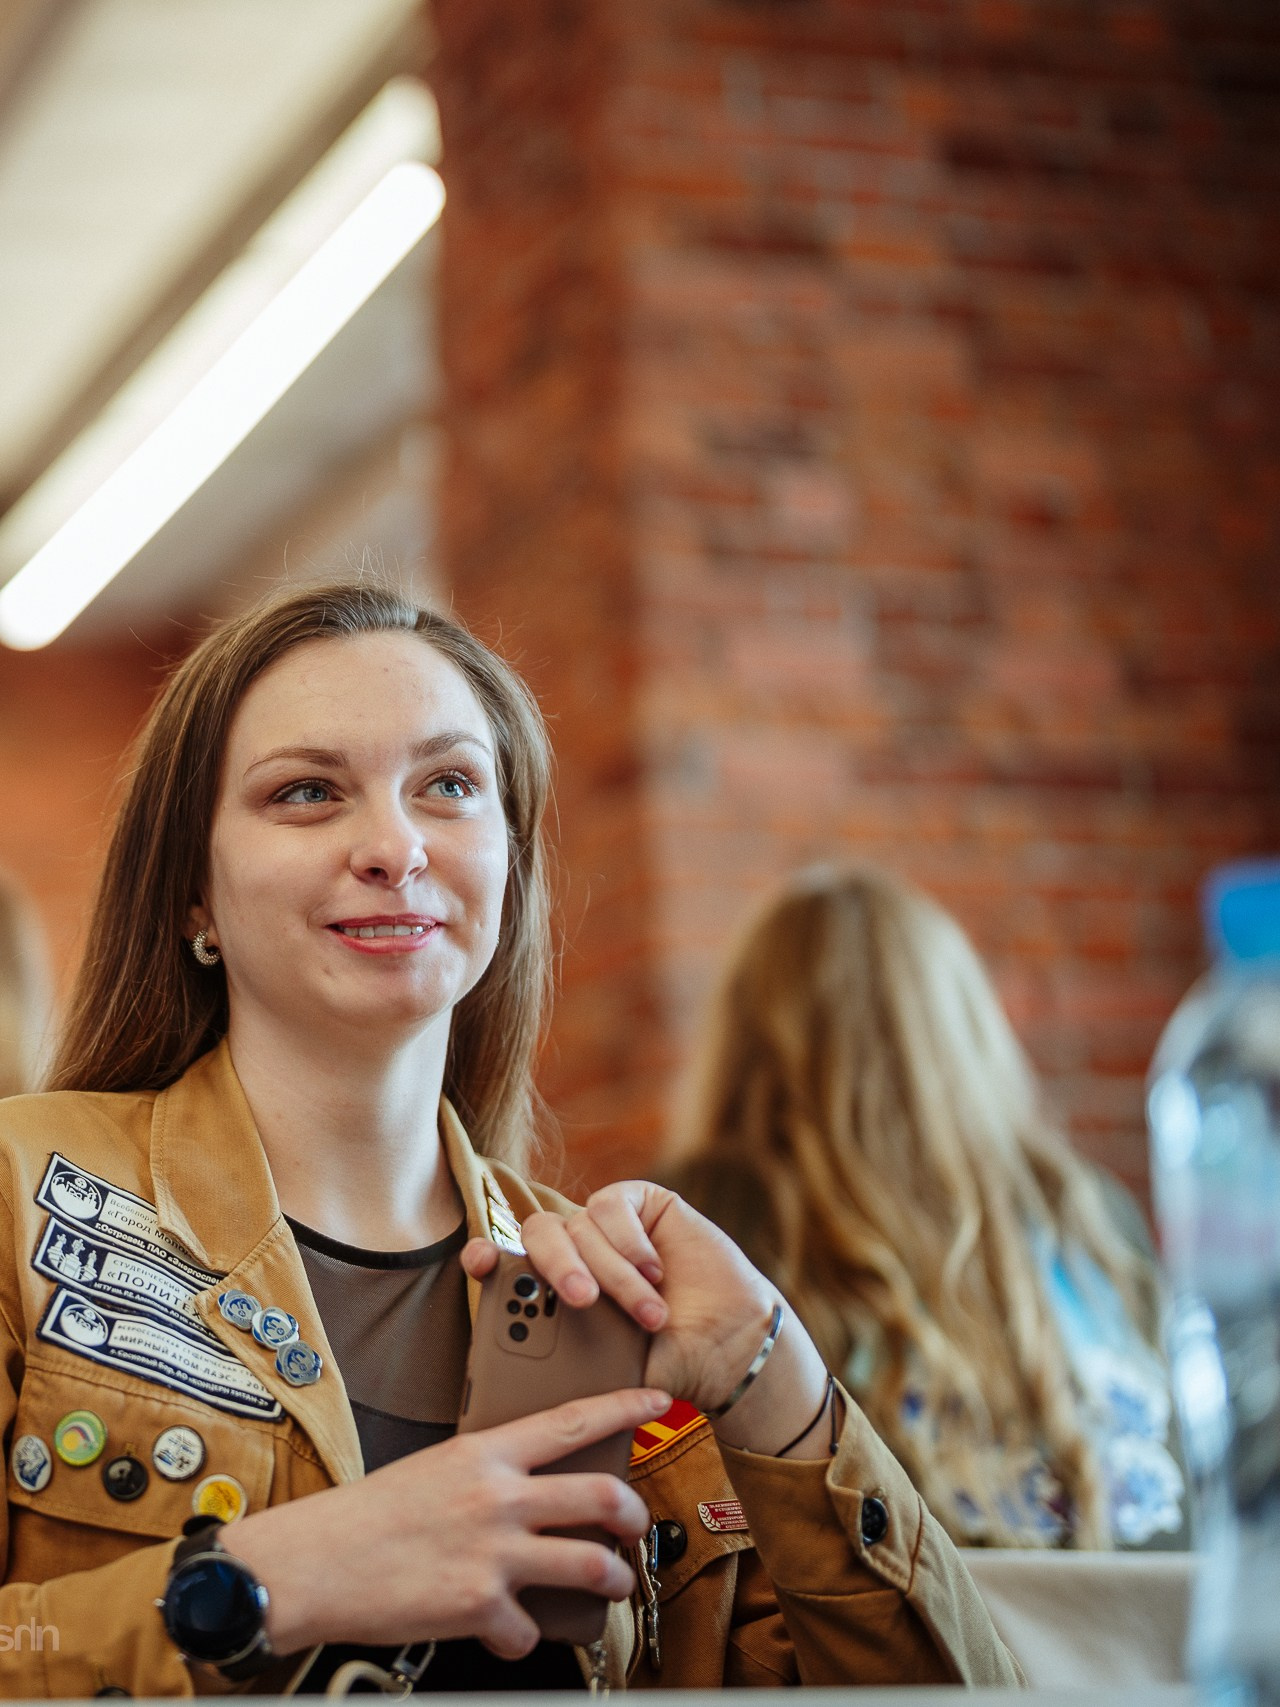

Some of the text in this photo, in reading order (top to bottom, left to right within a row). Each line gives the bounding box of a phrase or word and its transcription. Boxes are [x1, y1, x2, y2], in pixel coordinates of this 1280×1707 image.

[107, 1210, 151, 1235] «Город
[147, 1243, 168, 1259] ПАО
[113, 1259, 180, 1293] СТУДЕНЧЕСКИЙ
